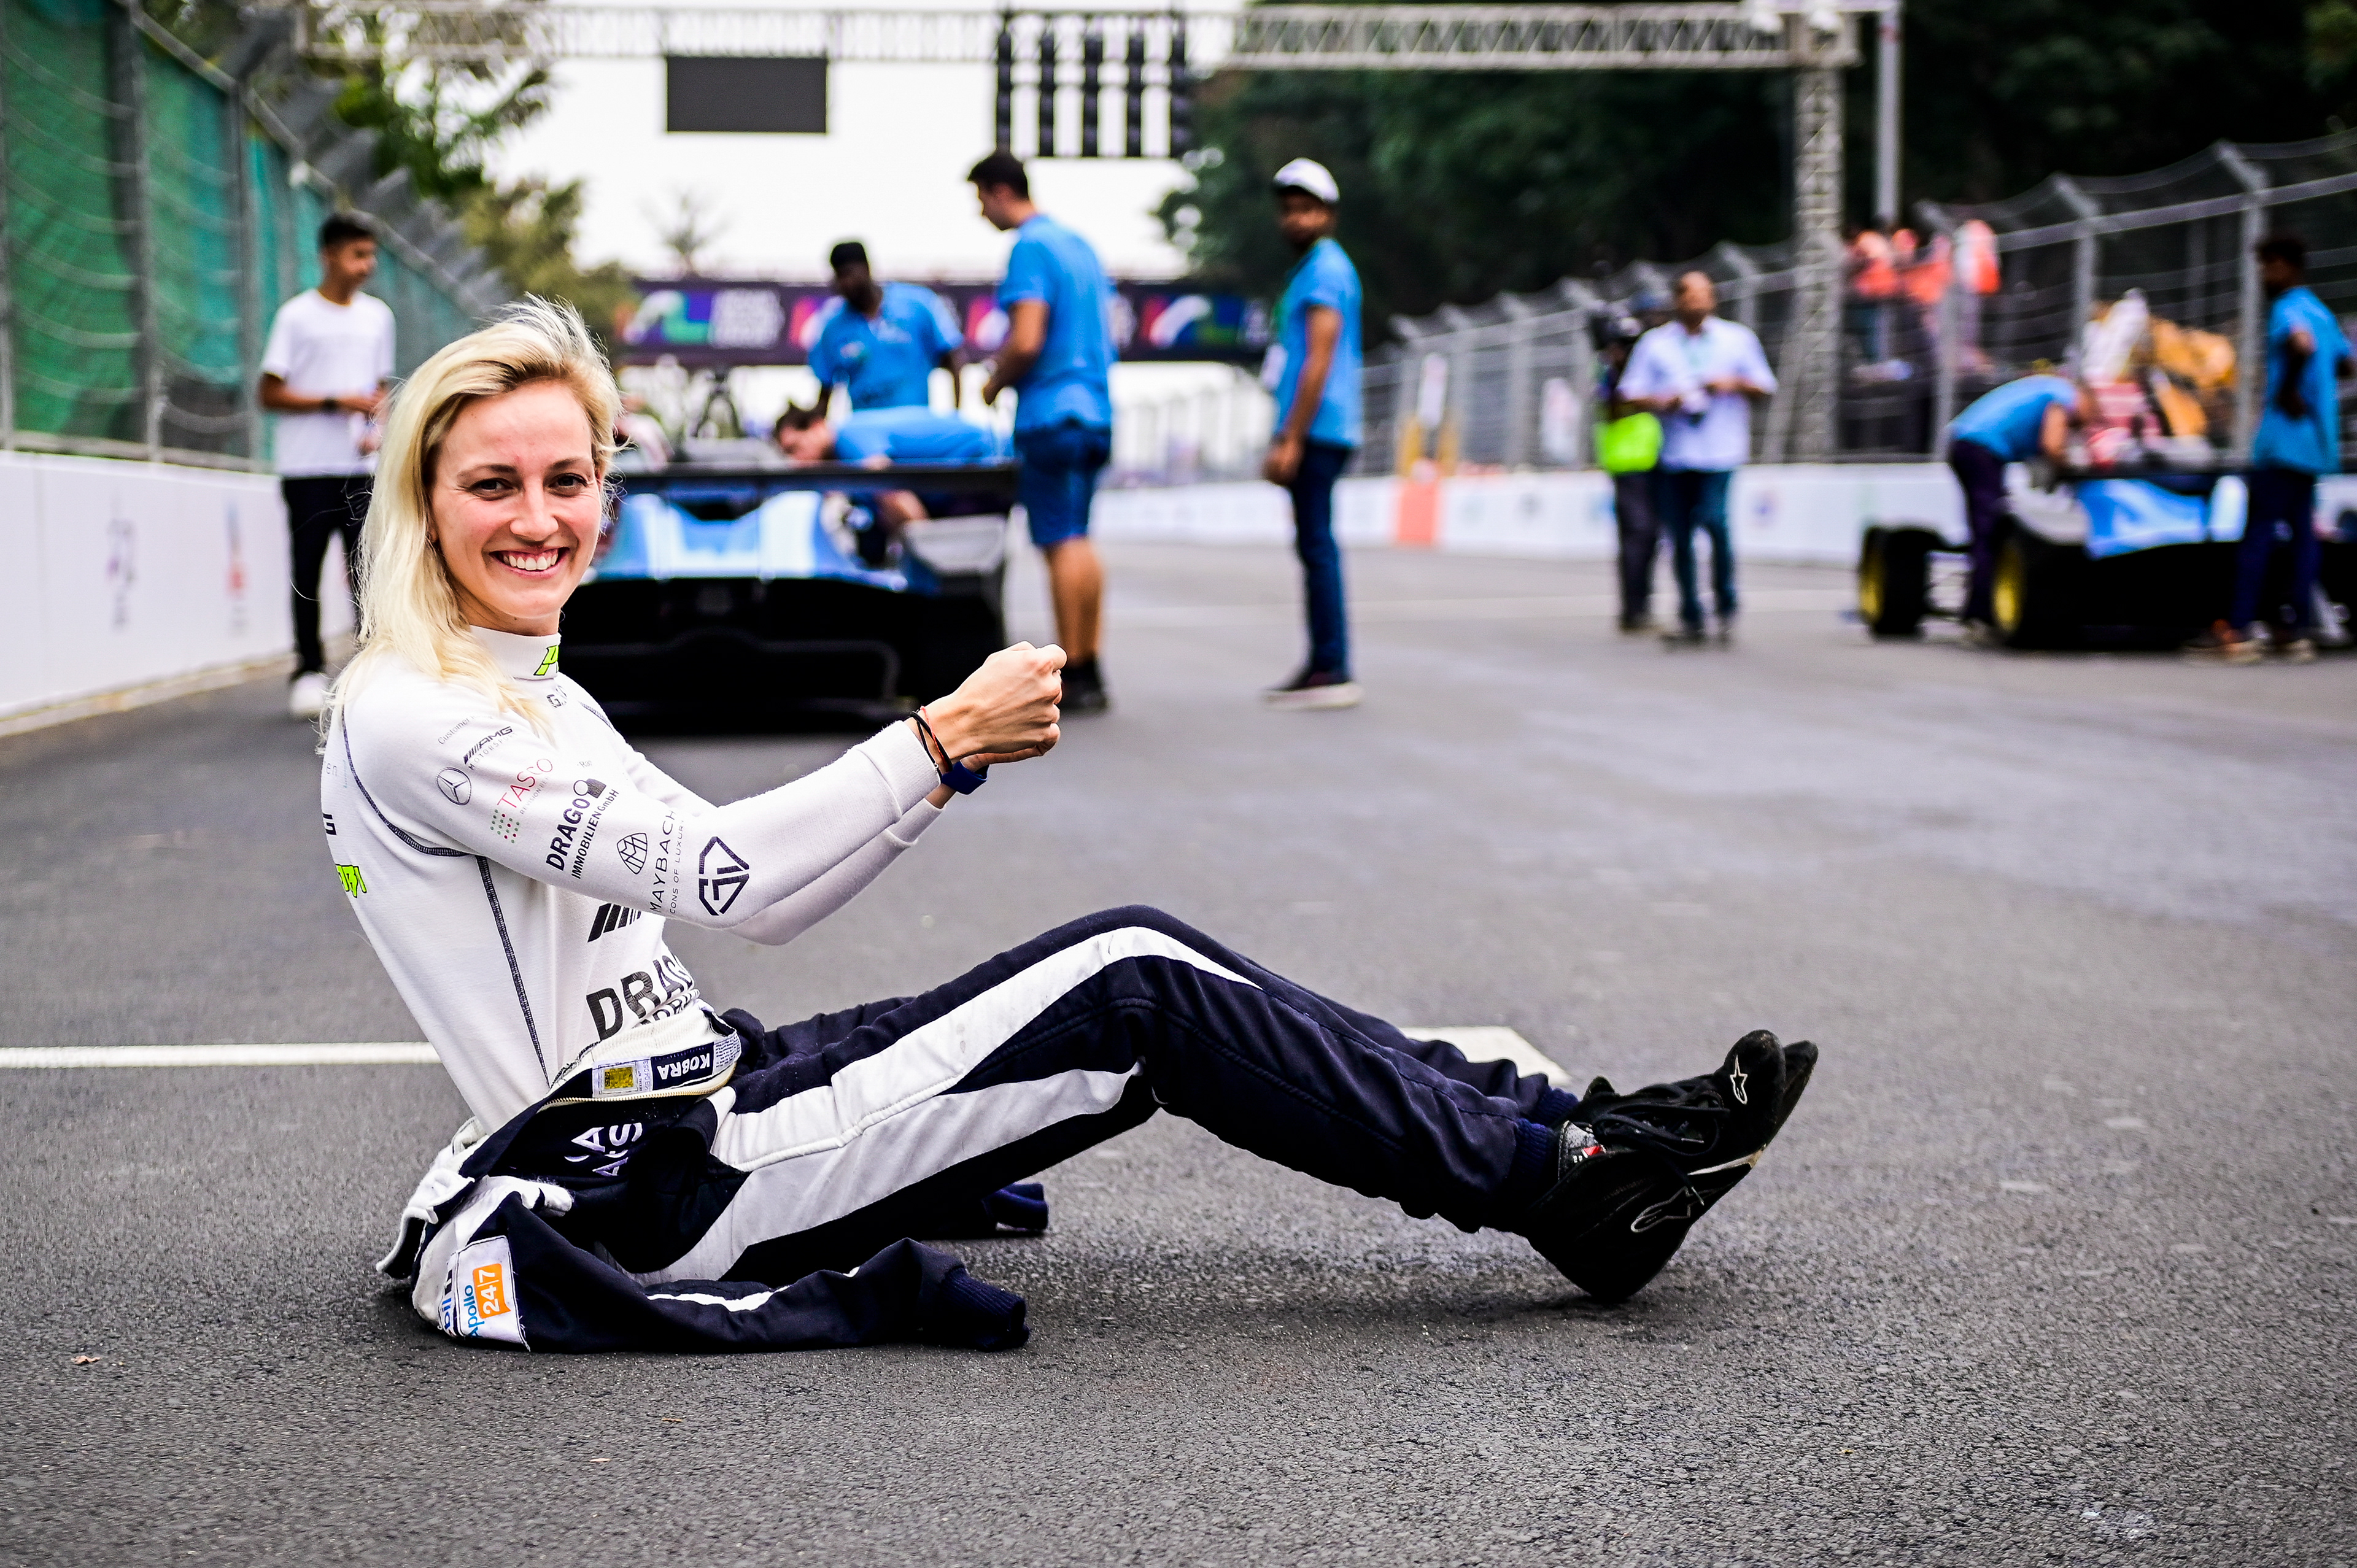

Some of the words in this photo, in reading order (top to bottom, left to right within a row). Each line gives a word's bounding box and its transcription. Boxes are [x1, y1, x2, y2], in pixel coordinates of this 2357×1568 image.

[497, 759, 552, 808] TASCO
[546, 798, 590, 871] DRAGO
[571, 811, 602, 879] IMMOBILIEN
[597, 789, 619, 812] GmbH
[649, 810, 676, 913] MAYBACH
[673, 868, 679, 883] OF
[586, 955, 694, 1041] DRAG
[657, 1052, 711, 1080] KOBRA
[463, 1284, 485, 1338] Apollo
